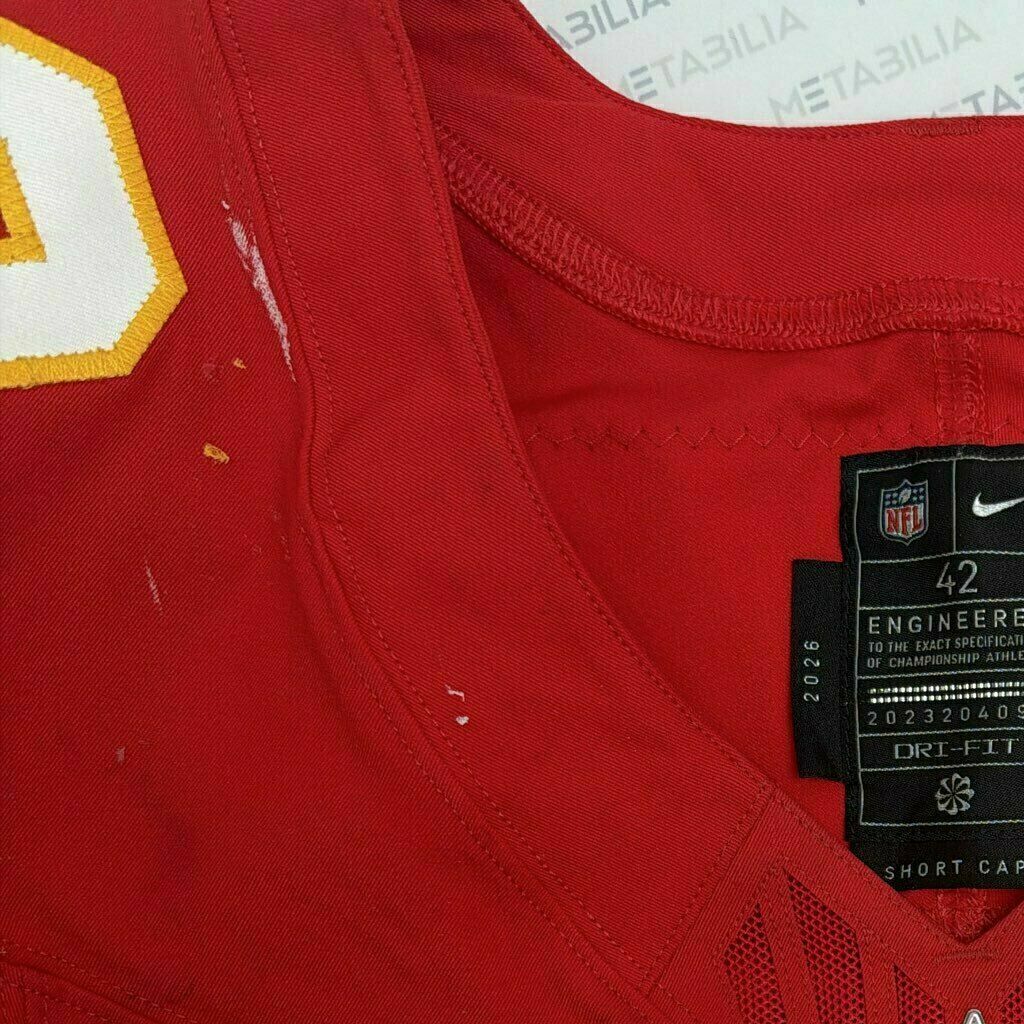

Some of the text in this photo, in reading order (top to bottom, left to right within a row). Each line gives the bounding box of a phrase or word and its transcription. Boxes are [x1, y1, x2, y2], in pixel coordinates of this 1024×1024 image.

[886, 505, 923, 536] NFL
[935, 559, 978, 595] 42
[868, 641, 884, 653] TO
[888, 640, 909, 652] THE
[916, 638, 951, 652] EXACT
[803, 640, 820, 702] 2026
[867, 657, 881, 669] OF
[889, 652, 980, 668] CHAMPIONSHIP
[894, 737, 1020, 760] DRI-FIT
[884, 860, 963, 880] SHORT
